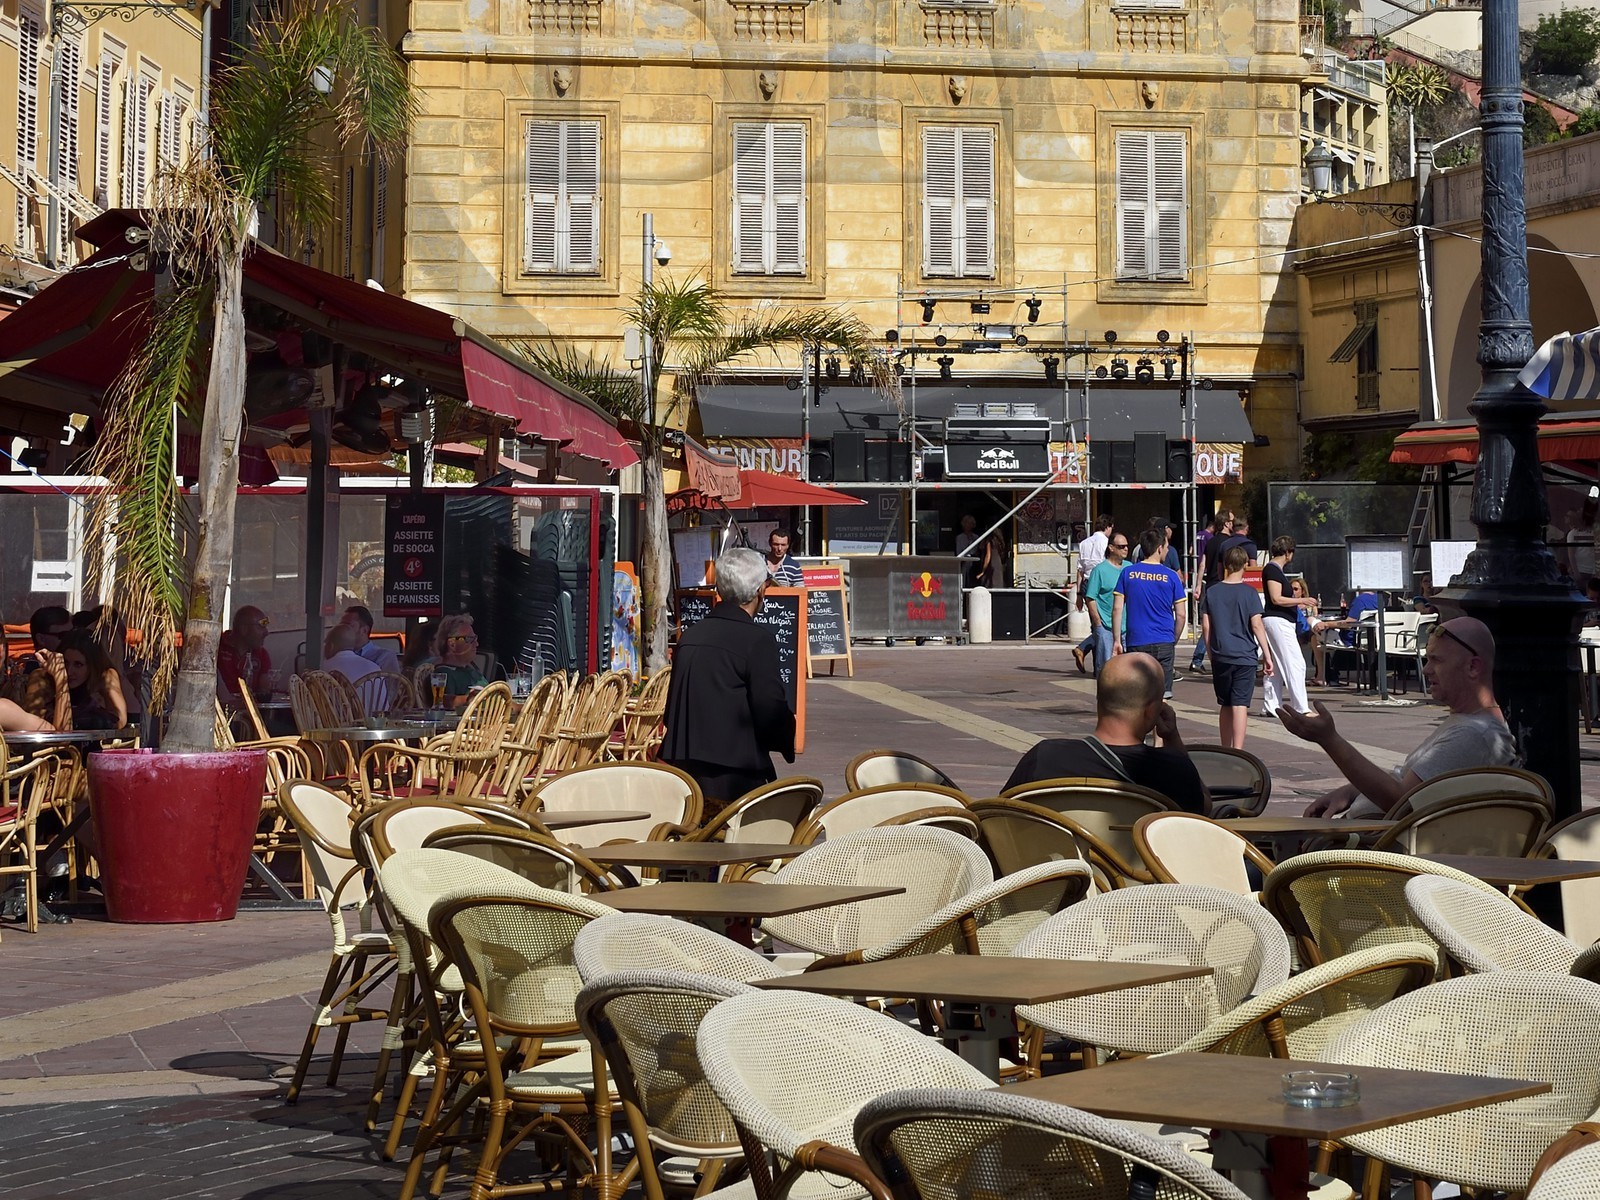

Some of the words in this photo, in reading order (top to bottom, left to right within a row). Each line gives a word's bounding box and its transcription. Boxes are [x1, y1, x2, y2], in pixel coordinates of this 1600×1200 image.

[977, 460, 998, 469] Red
[999, 460, 1019, 469] Bull
[1196, 453, 1240, 477] QUE
[881, 497, 897, 511] DZ
[394, 531, 434, 540] ASSIETTE
[393, 544, 404, 553] DE
[405, 544, 435, 553] SOCCA
[406, 560, 421, 574] 4€
[1129, 571, 1169, 583] SVERIGE
[393, 581, 433, 590] ASSIETTE
[386, 595, 399, 604] DE
[399, 595, 440, 604] PANISSES
